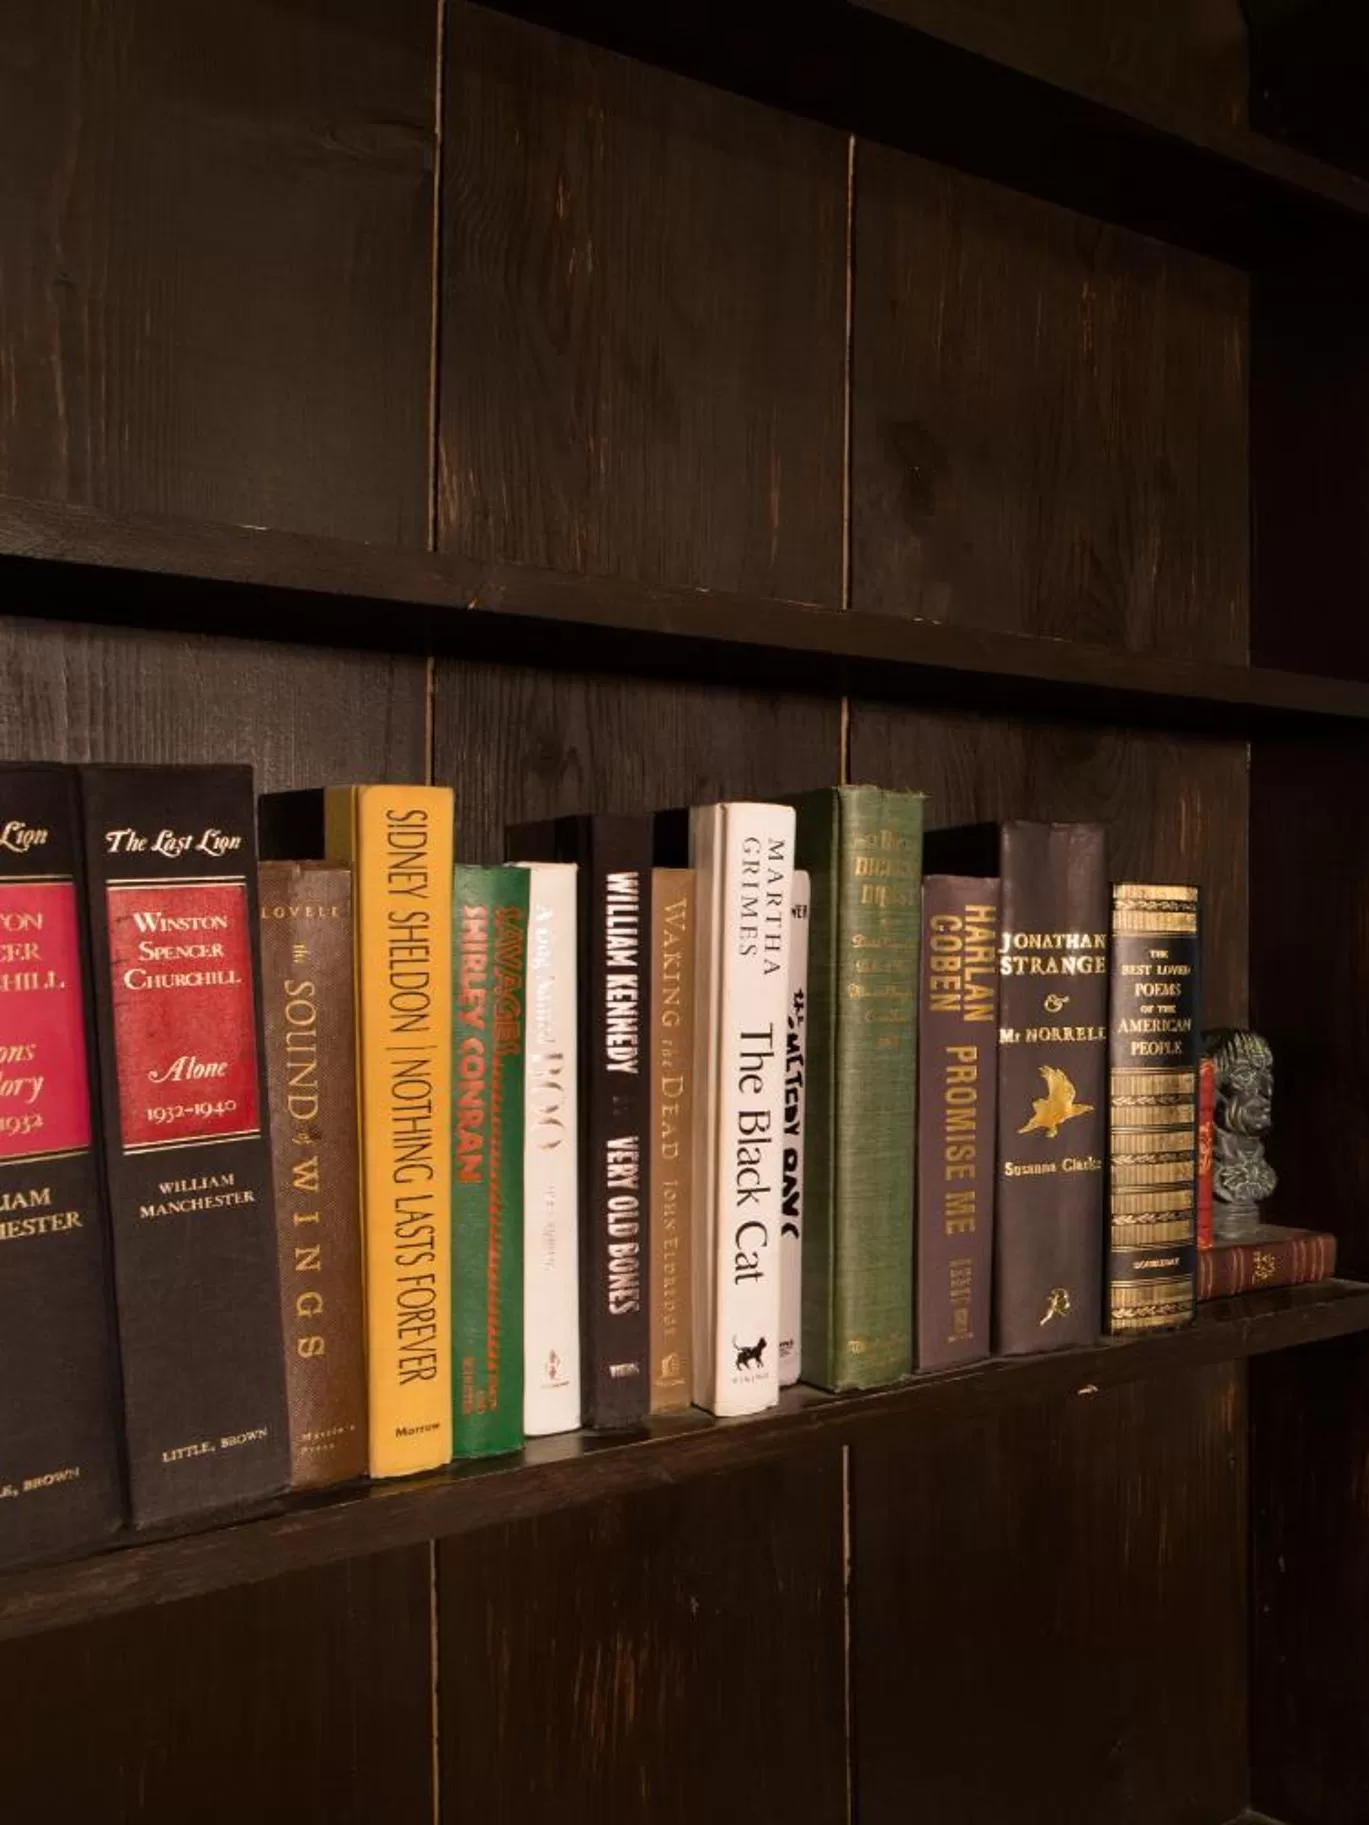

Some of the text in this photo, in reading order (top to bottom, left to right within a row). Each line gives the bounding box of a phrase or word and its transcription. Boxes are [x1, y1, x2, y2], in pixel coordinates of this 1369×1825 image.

[105, 828, 241, 858] The Last Lion
[739, 836, 762, 957] GRIMES
[764, 838, 785, 975] MARTHA
[133, 912, 228, 933] WINSTON
[138, 941, 225, 961] SPENCER
[999, 932, 1107, 953] JONATHAN
[606, 872, 639, 1075] WILLIAM KENNEDY
[661, 898, 687, 1027] WAKING
[930, 914, 963, 1013] COBEN
[963, 904, 996, 1022] HARLAN
[1000, 955, 1107, 976] STRANGE
[1122, 964, 1152, 976] BEST
[124, 967, 243, 991] CHURCHILL
[1135, 983, 1181, 997] POEMS
[1044, 994, 1070, 1013] &
[1026, 1026, 1107, 1043] NORRELL
[1118, 1018, 1192, 1033] AMERICAN
[283, 979, 319, 1121] SOUND
[456, 905, 488, 1185] SHIRLEY CONRAN
[1131, 1041, 1182, 1056] PEOPLE
[149, 1056, 228, 1083] Alone
[386, 809, 438, 1386] SIDNEY SHELDON NOTHING LASTS FOREVER
[147, 1100, 236, 1125] 1932-1940
[661, 1076, 684, 1158] DEAD
[945, 1045, 978, 1181] PROMISE
[734, 1021, 775, 1286] The Black Cat
[159, 1172, 235, 1196] WILLIAM
[139, 1190, 255, 1219] MANCHESTER
[945, 1191, 976, 1235] ME
[606, 1136, 641, 1316] VERY OLD BONES
[292, 1155, 326, 1359] WINGS
[221, 1427, 268, 1450] BROWN
[395, 1422, 441, 1438] Morrow
[23, 1466, 80, 1492] BROWN
